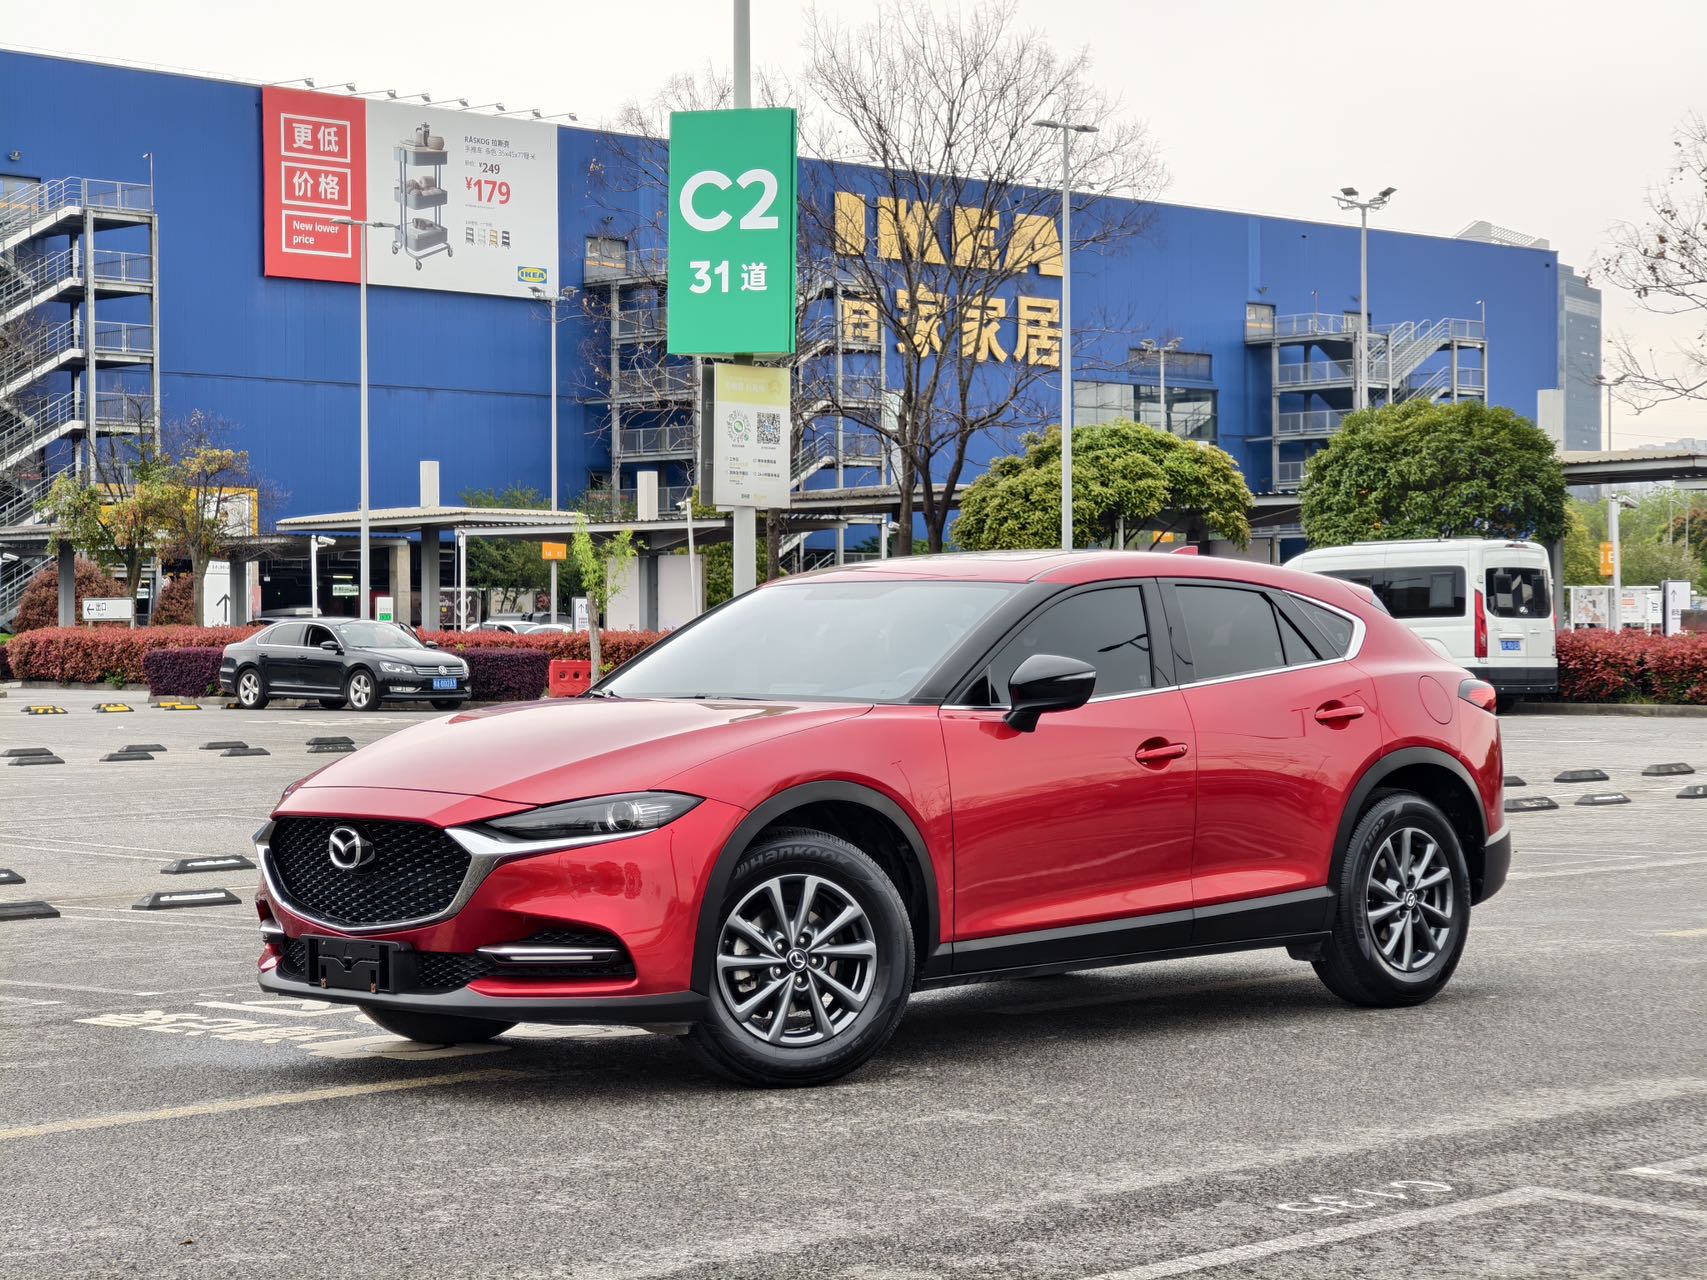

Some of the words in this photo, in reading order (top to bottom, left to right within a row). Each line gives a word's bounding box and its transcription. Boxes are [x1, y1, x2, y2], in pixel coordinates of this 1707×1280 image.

[292, 123, 339, 153] 更低
[292, 170, 340, 201] 价格
[465, 175, 511, 205] ¥179
[679, 168, 779, 232] C2
[292, 219, 314, 231] New
[314, 220, 340, 235] lower
[292, 233, 316, 246] price
[834, 191, 1064, 277] IKEA
[520, 270, 546, 280] IKEA
[689, 260, 730, 294] 31
[740, 261, 768, 292] 道
